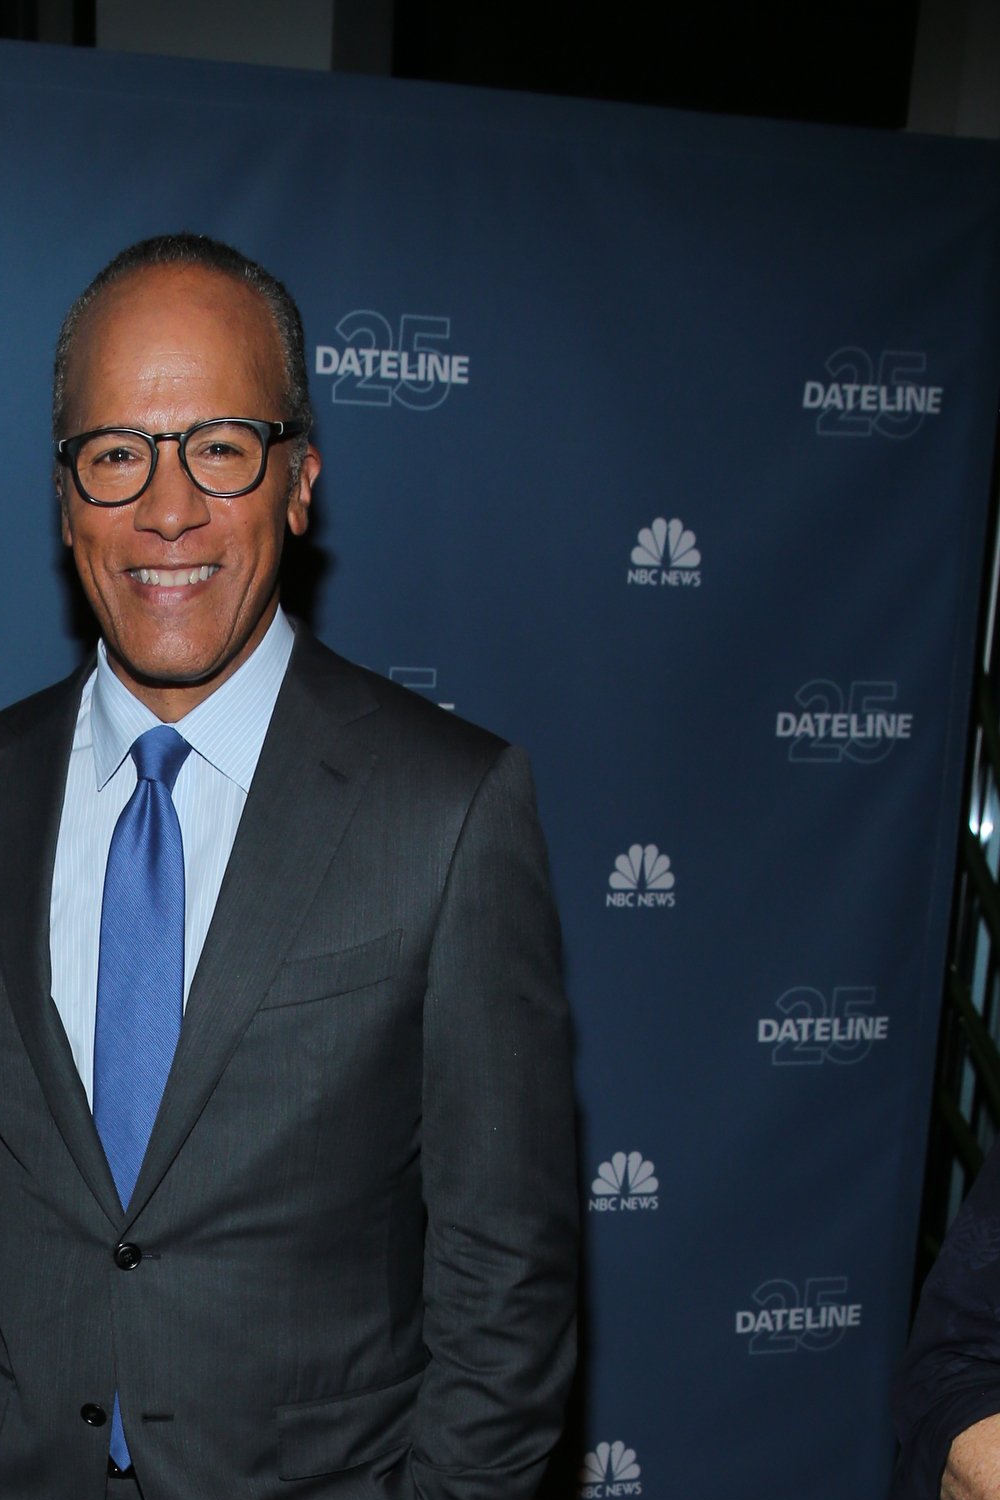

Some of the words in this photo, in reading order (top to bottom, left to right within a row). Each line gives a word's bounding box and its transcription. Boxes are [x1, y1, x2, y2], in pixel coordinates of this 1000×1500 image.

[315, 346, 469, 385] DATELINE
[332, 309, 451, 411] 25
[802, 381, 943, 414] DATELINE
[627, 568, 658, 586] NBC
[660, 570, 701, 587] NEWS
[776, 711, 913, 739] DATELINE
[605, 892, 635, 908] NBC
[637, 892, 676, 908] NEWS
[757, 1016, 889, 1043] DATELINE
[588, 1199, 618, 1212] NBC
[620, 1196, 659, 1211] NEWS
[735, 1304, 862, 1334] DATELINE
[605, 1482, 642, 1497] NEWS
